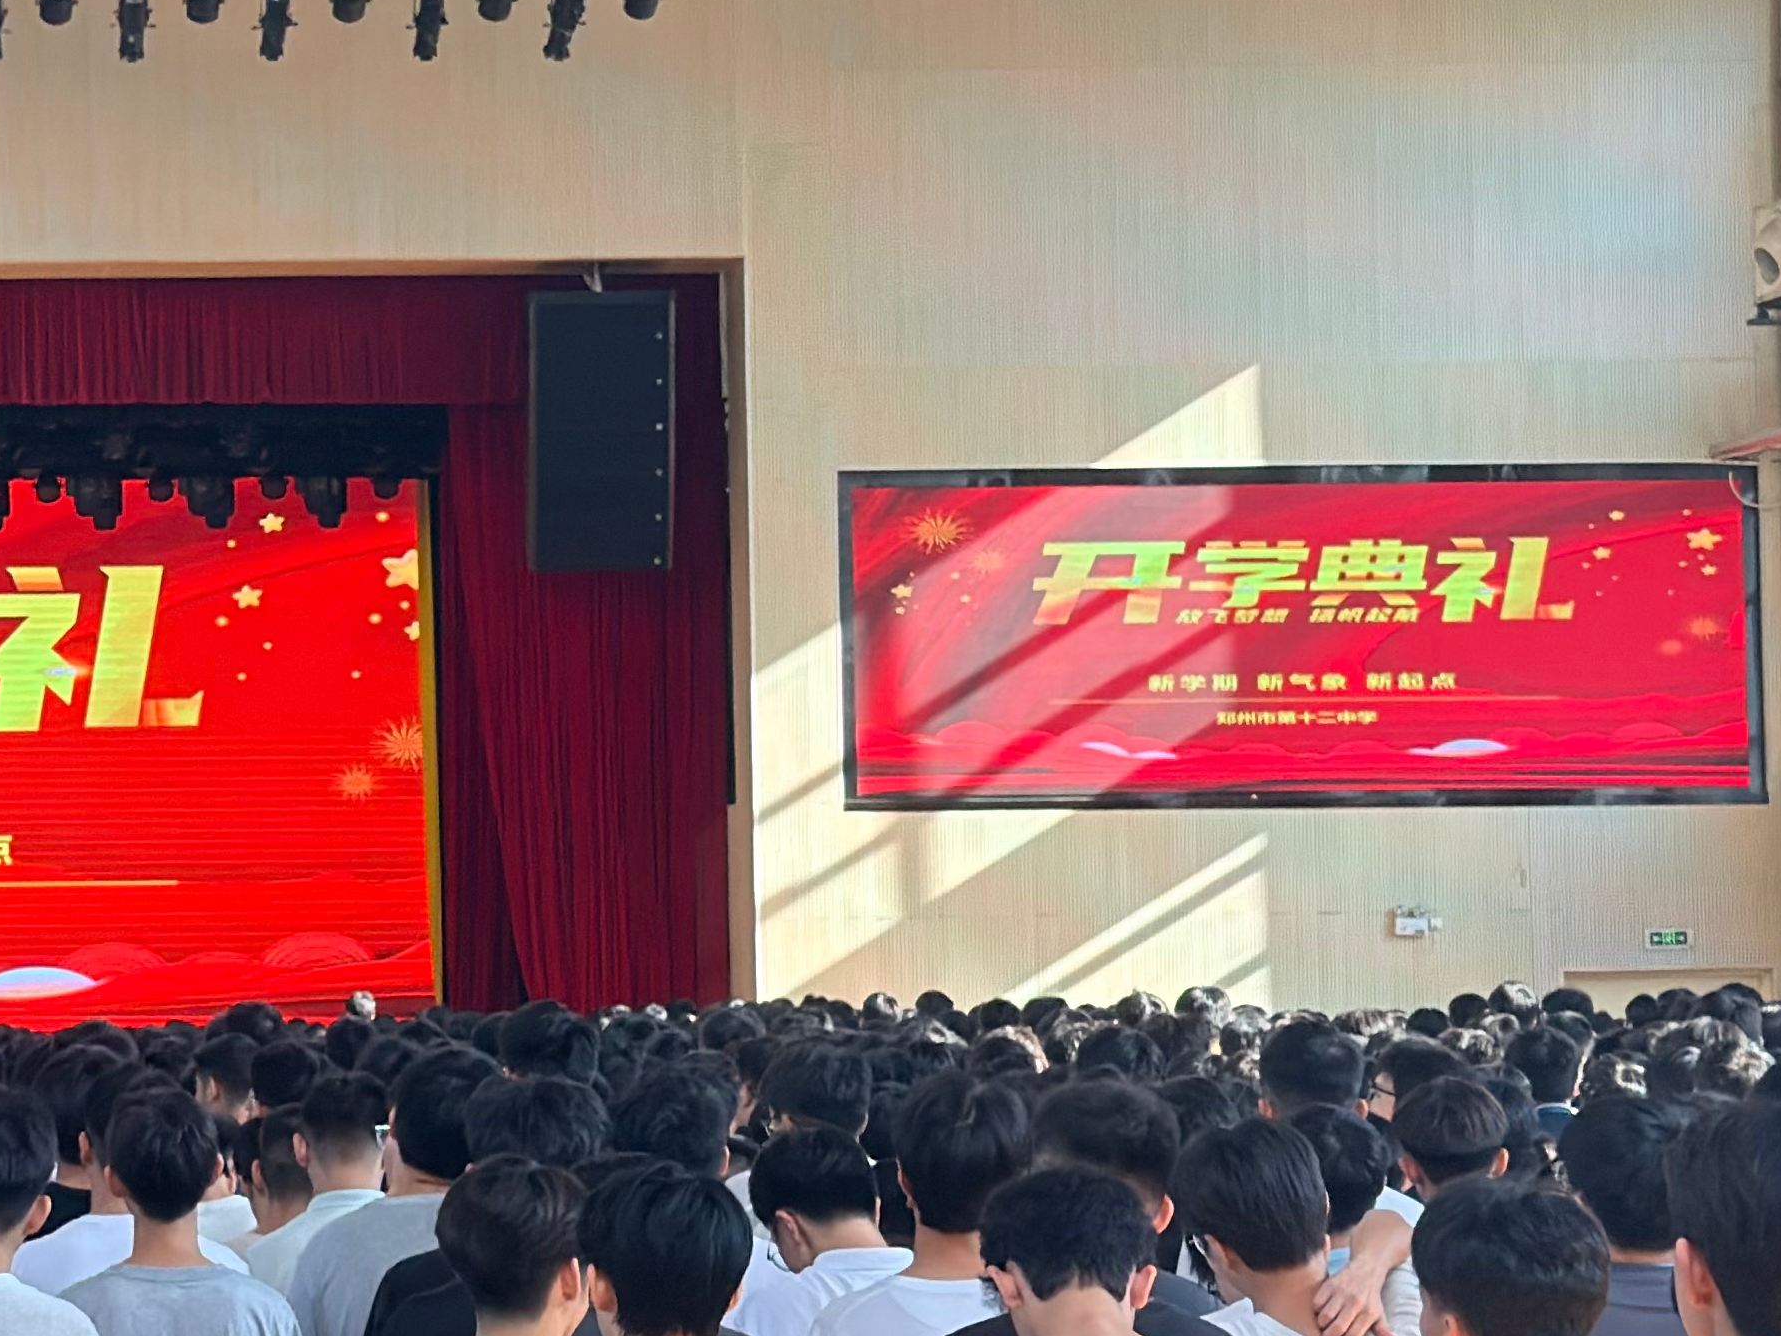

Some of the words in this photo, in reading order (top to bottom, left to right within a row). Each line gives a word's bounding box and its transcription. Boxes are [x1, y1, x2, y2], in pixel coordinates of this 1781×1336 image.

[1035, 536, 1572, 624] 开学典礼
[1148, 674, 1239, 693] 新学期
[1256, 673, 1347, 692] 新气象
[1365, 672, 1456, 691] 新起点
